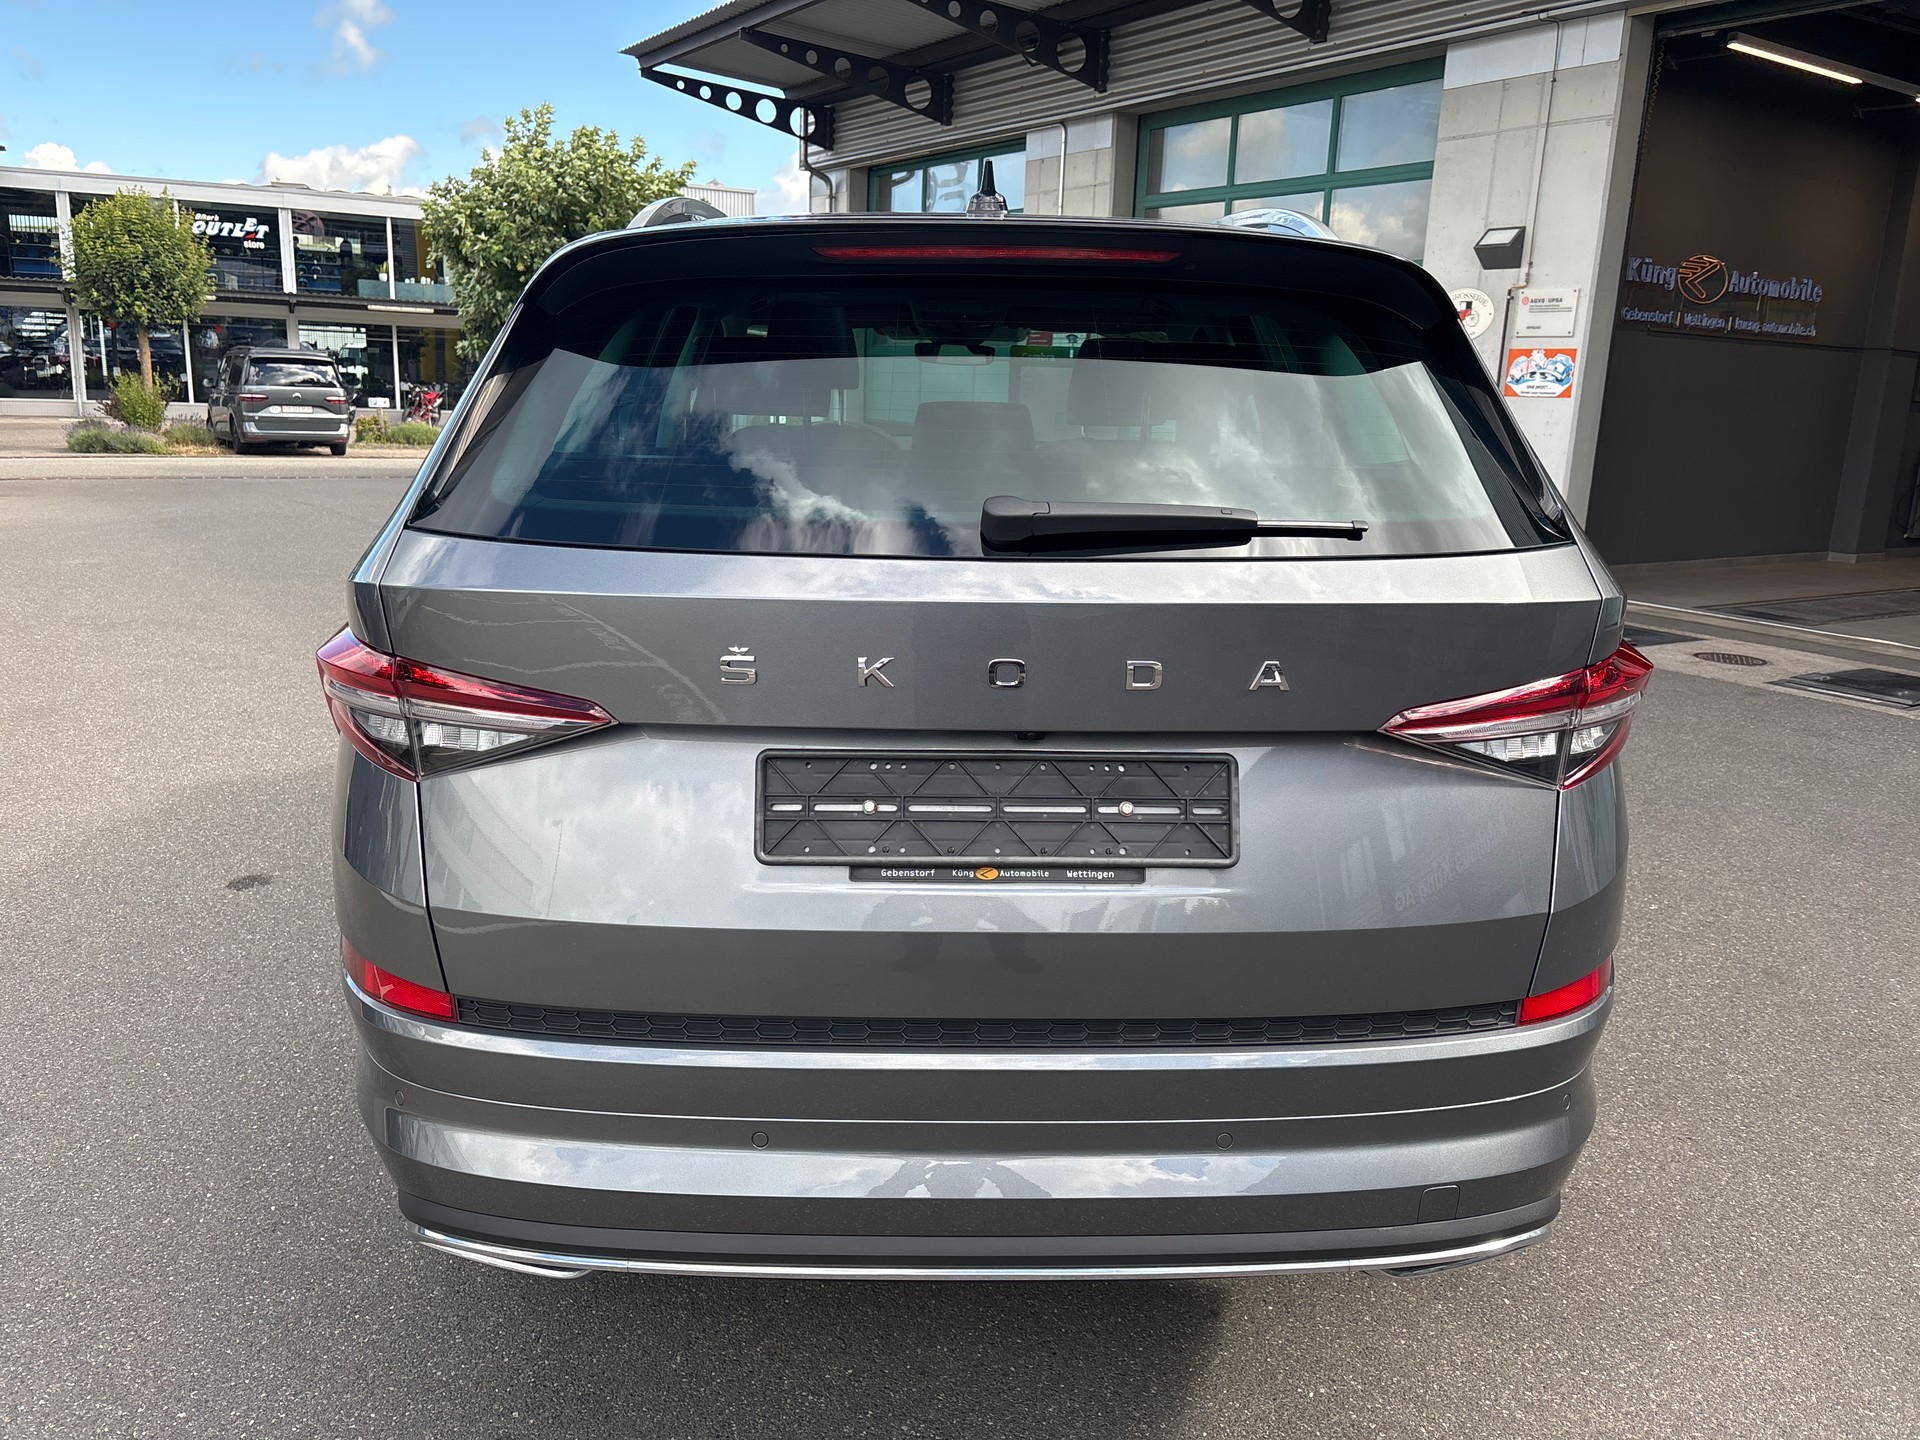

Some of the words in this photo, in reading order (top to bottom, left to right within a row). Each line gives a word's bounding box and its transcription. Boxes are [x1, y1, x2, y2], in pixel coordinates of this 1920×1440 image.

[191, 217, 269, 239] OUTLET
[243, 240, 265, 249] store
[1625, 256, 1678, 291] Küng
[1728, 270, 1823, 302] Automobile
[1623, 306, 1675, 324] Gebenstorf
[1683, 312, 1726, 329] Wettingen
[720, 645, 1291, 692] ŠKODA
[880, 868, 936, 878] Gebenstorf
[952, 869, 975, 879] Küng
[999, 869, 1050, 878] Automobile
[1066, 869, 1116, 880] Wettingen
